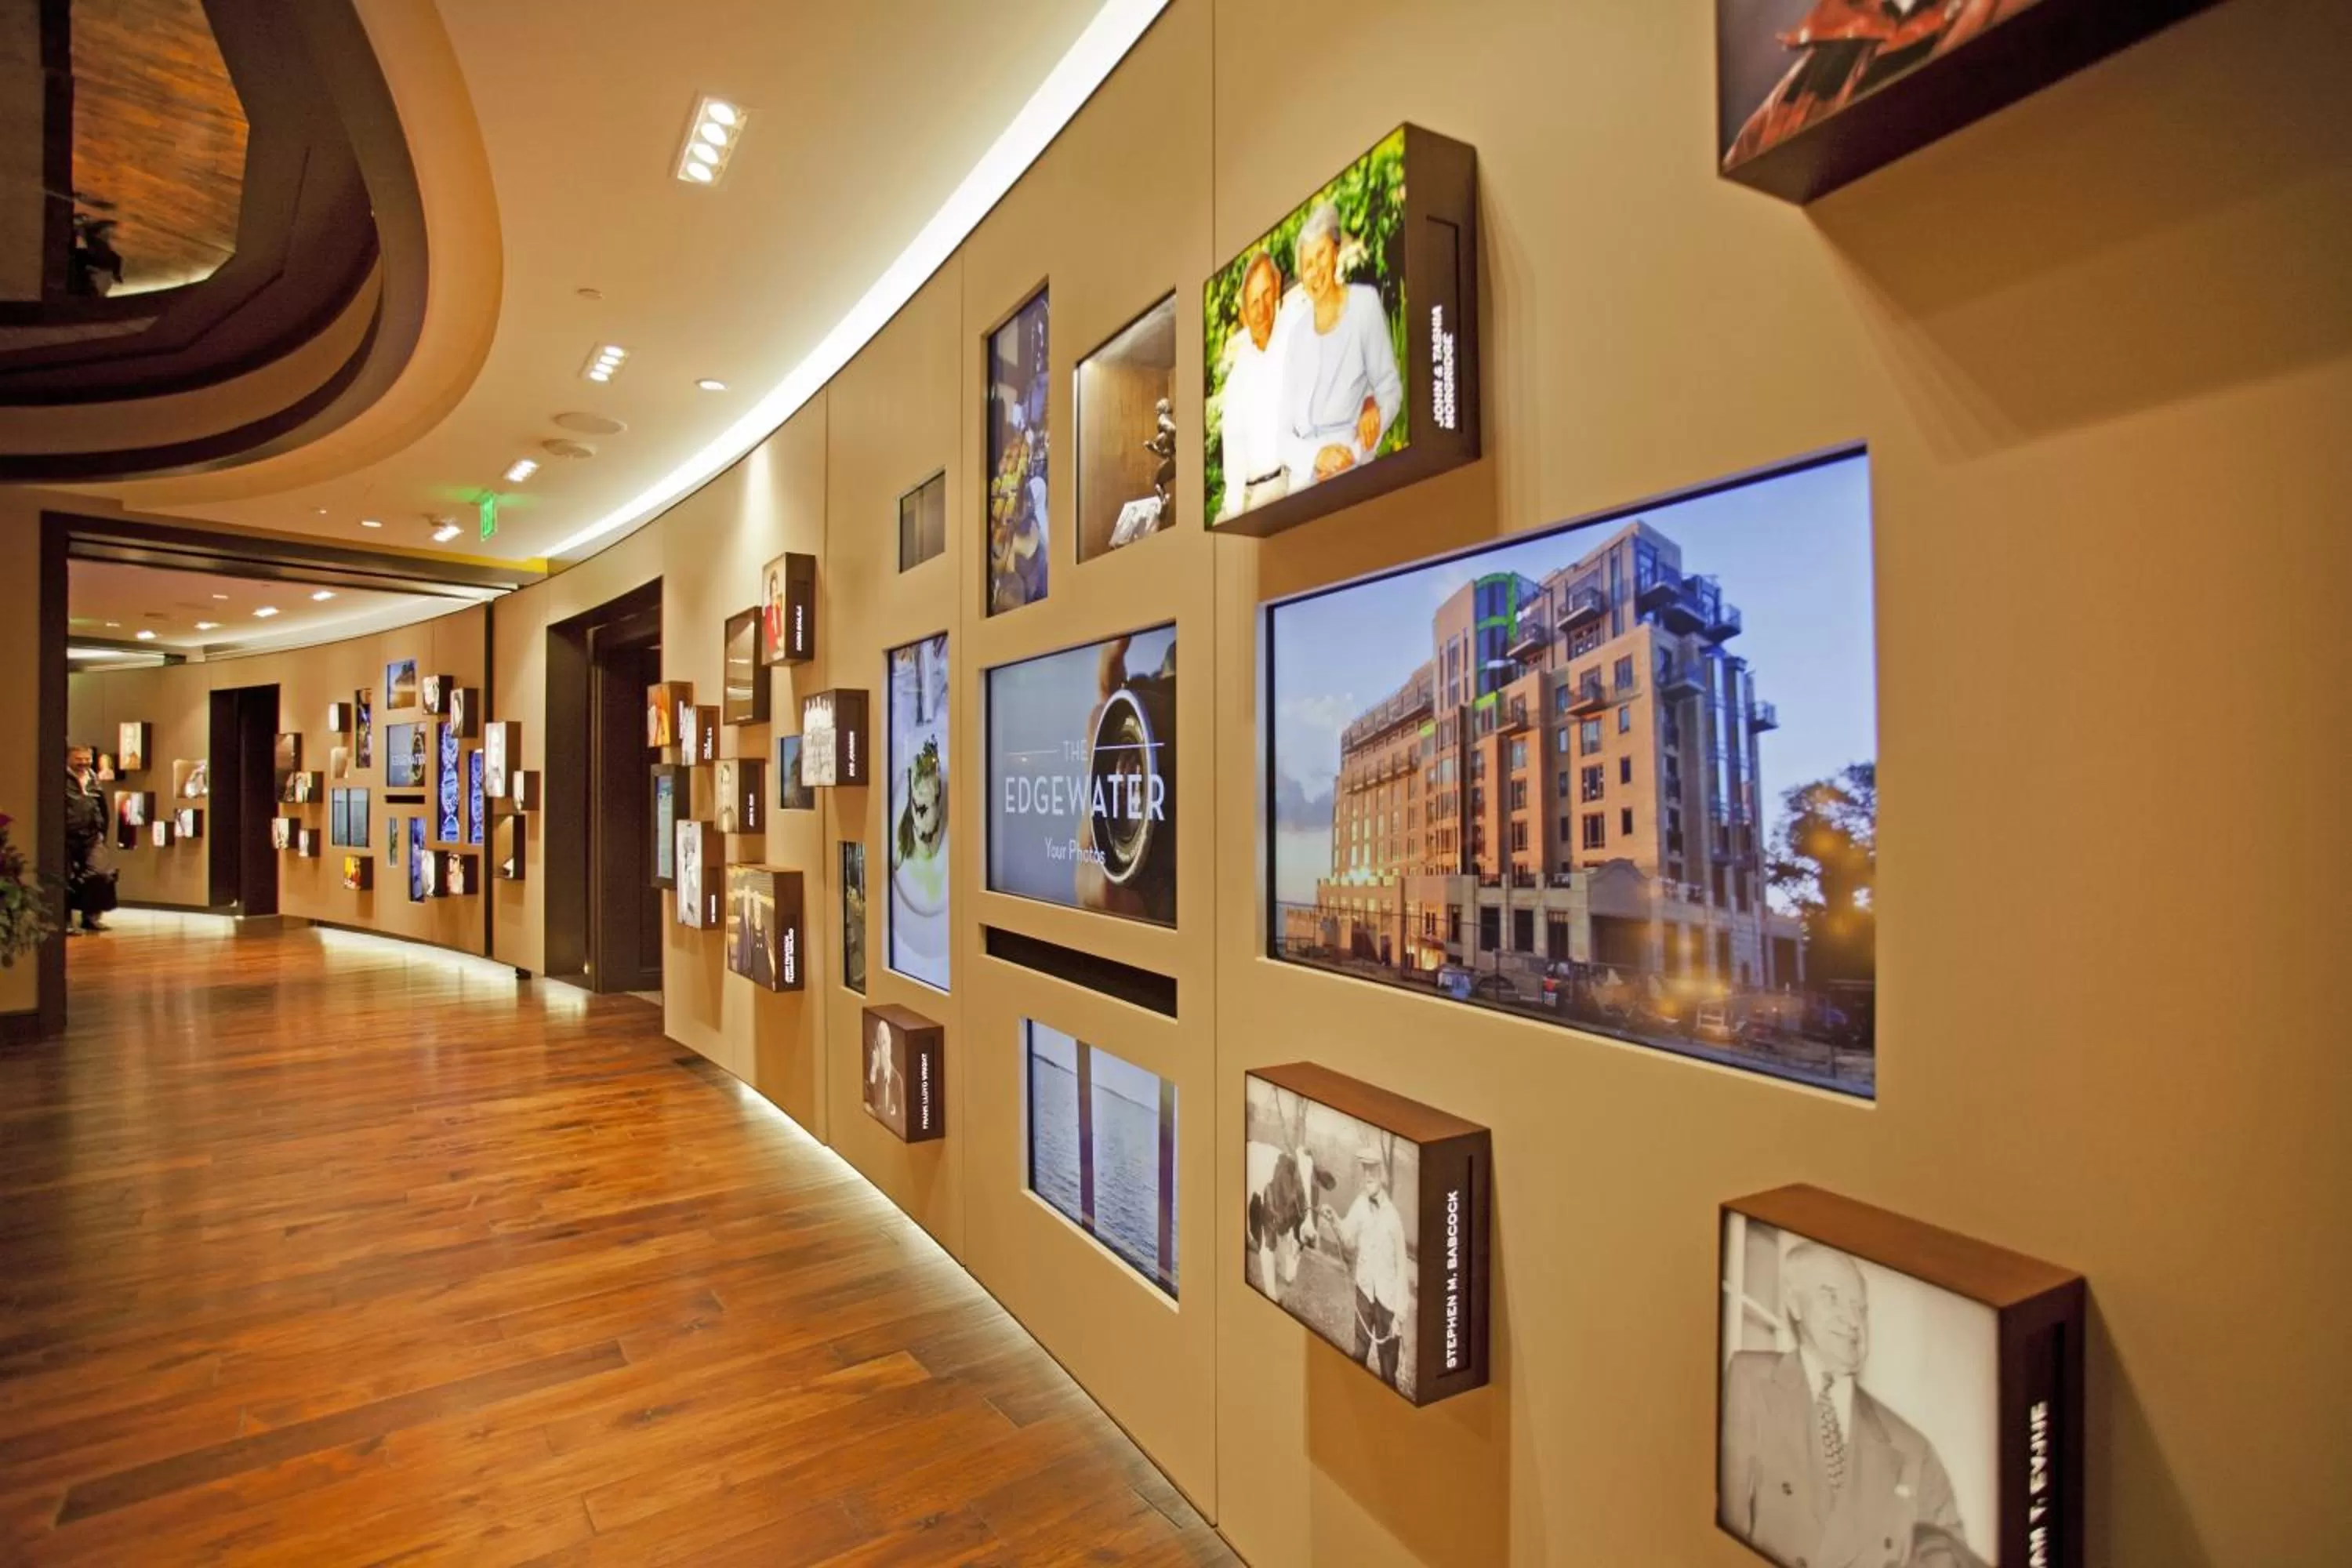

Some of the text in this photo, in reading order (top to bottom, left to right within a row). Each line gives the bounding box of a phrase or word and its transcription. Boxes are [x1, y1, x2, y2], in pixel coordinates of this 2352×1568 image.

[1431, 304, 1444, 428] JOHN & TASHIA
[1443, 332, 1454, 429] MORGRIDGE
[1062, 739, 1088, 762] THE
[1004, 773, 1166, 821] EDGEWATER
[1044, 836, 1106, 864] Your Photos
[1446, 1189, 1458, 1369] STEPHEN M. BABCOCK
